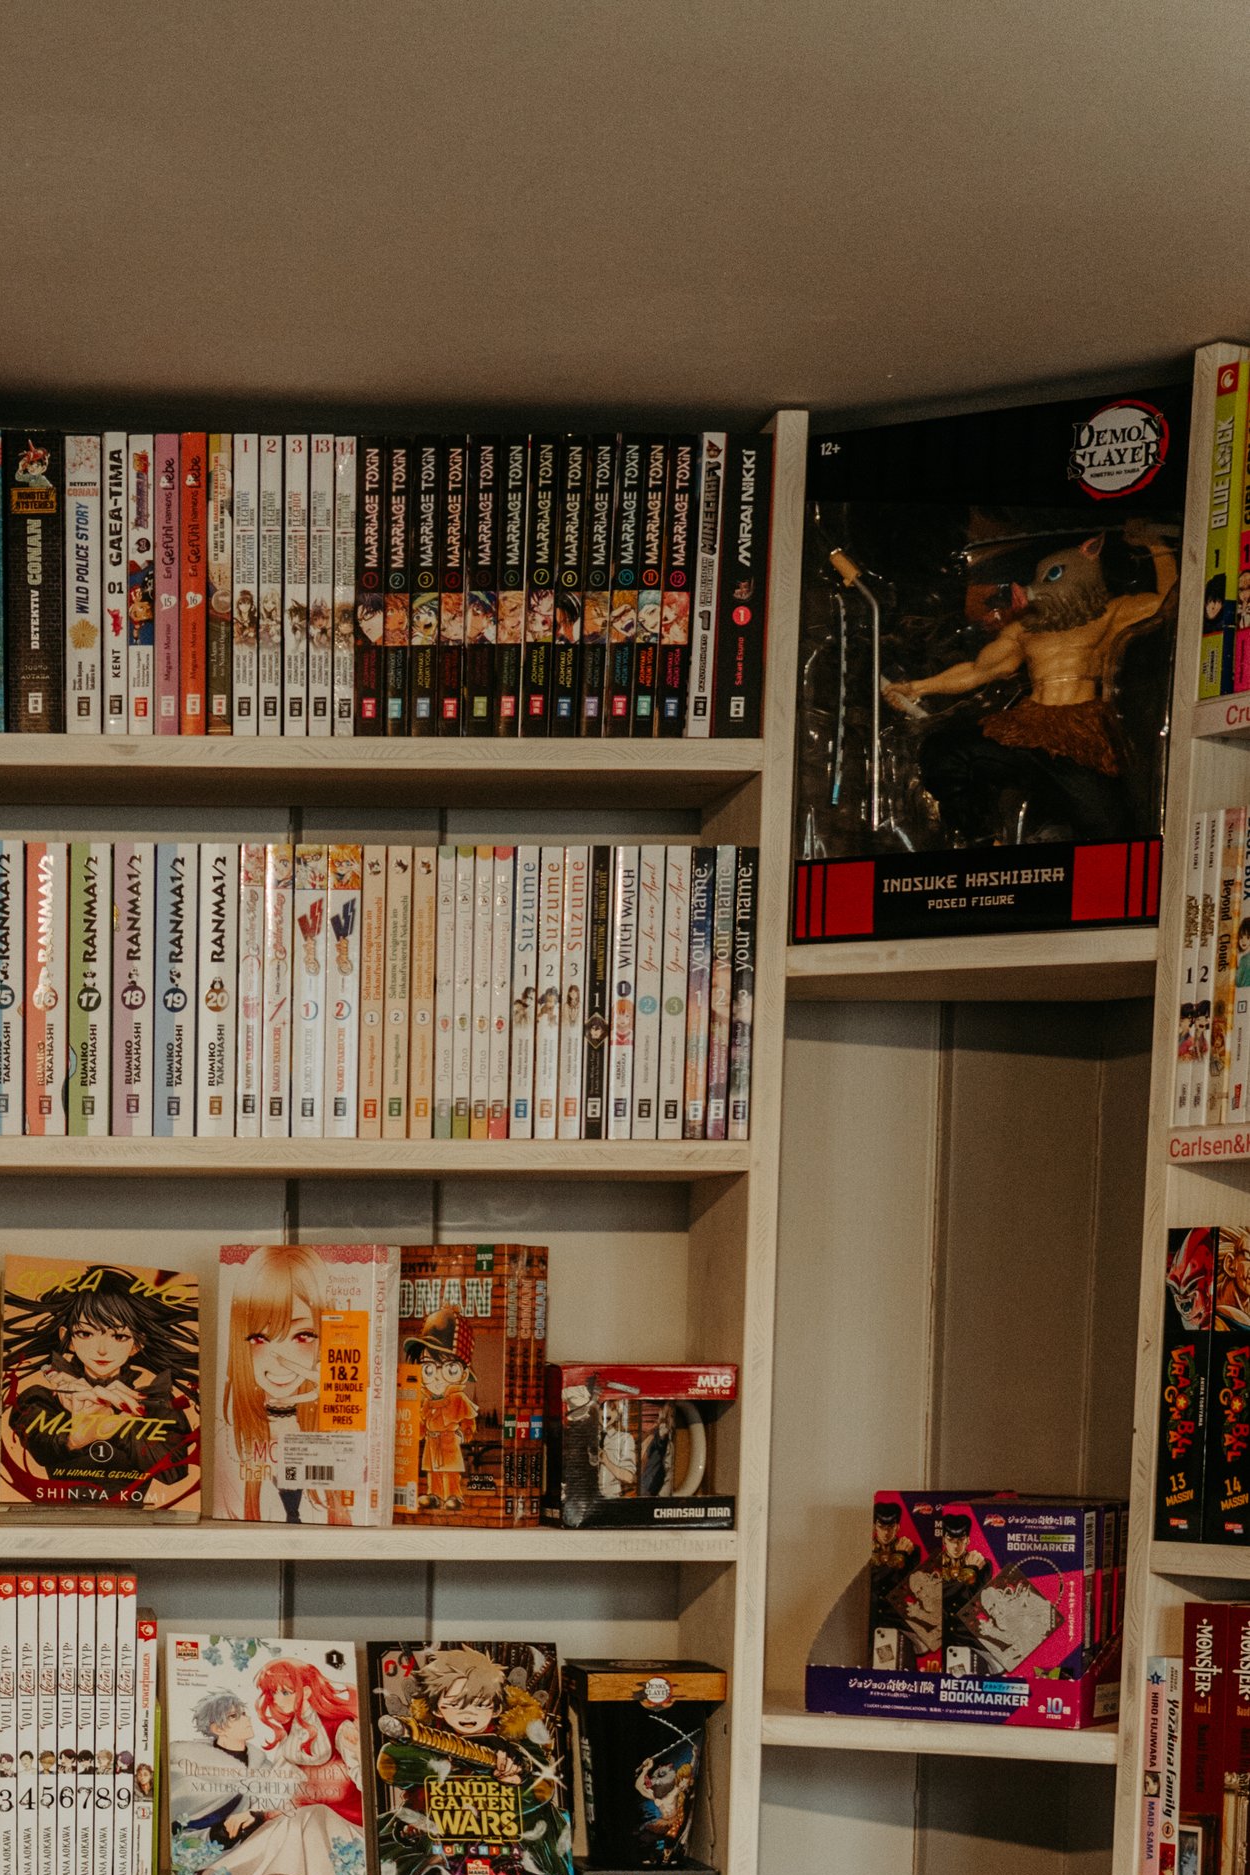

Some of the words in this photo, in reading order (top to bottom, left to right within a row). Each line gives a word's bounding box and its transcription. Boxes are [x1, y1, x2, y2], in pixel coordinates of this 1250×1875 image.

[1070, 416, 1164, 452] DEMON
[820, 442, 841, 456] 12+
[1067, 446, 1165, 482] SLAYER
[108, 447, 124, 566] GAEA-TIMA
[702, 461, 722, 555] MINECRAFT
[1209, 473, 1233, 529] BLUE
[76, 503, 89, 539] STORY
[75, 541, 89, 587] POLICE
[108, 582, 123, 594] 01
[75, 589, 89, 614] WILD
[111, 649, 121, 678] KENT
[739, 862, 753, 917] name.
[881, 873, 958, 893] INOSUKE
[964, 867, 1065, 888] HASHIBIRA
[518, 862, 536, 952] Suzume
[621, 869, 635, 921] WATCH
[926, 897, 967, 910] POSED
[971, 894, 1015, 908] FIGURE
[619, 923, 633, 969] WITCH
[735, 921, 753, 972] your
[16, 1270, 104, 1295] SORA
[129, 1276, 191, 1304] WO
[327, 1349, 361, 1363] BAND
[330, 1367, 358, 1380] 1&2
[698, 1375, 732, 1388] MUG
[334, 1383, 364, 1392] BUNDLE
[335, 1394, 351, 1403] ZUM
[323, 1404, 363, 1414] EINSTIGES-
[332, 1415, 353, 1425] PREIS
[25, 1410, 178, 1442] MATOTTE
[36, 1487, 109, 1501] SHIN-YA
[120, 1490, 166, 1503] KOMI
[653, 1507, 696, 1517] CHAINSAW
[700, 1507, 731, 1517] MAN
[940, 1678, 982, 1691] METAL
[940, 1691, 1028, 1707] BOOKMARKER
[1148, 1691, 1158, 1717] HIRO
[1148, 1720, 1159, 1768] FUJIWARA
[429, 1781, 515, 1796] KINDER
[429, 1796, 515, 1811] GARTEN
[431, 1811, 518, 1836] WARS
